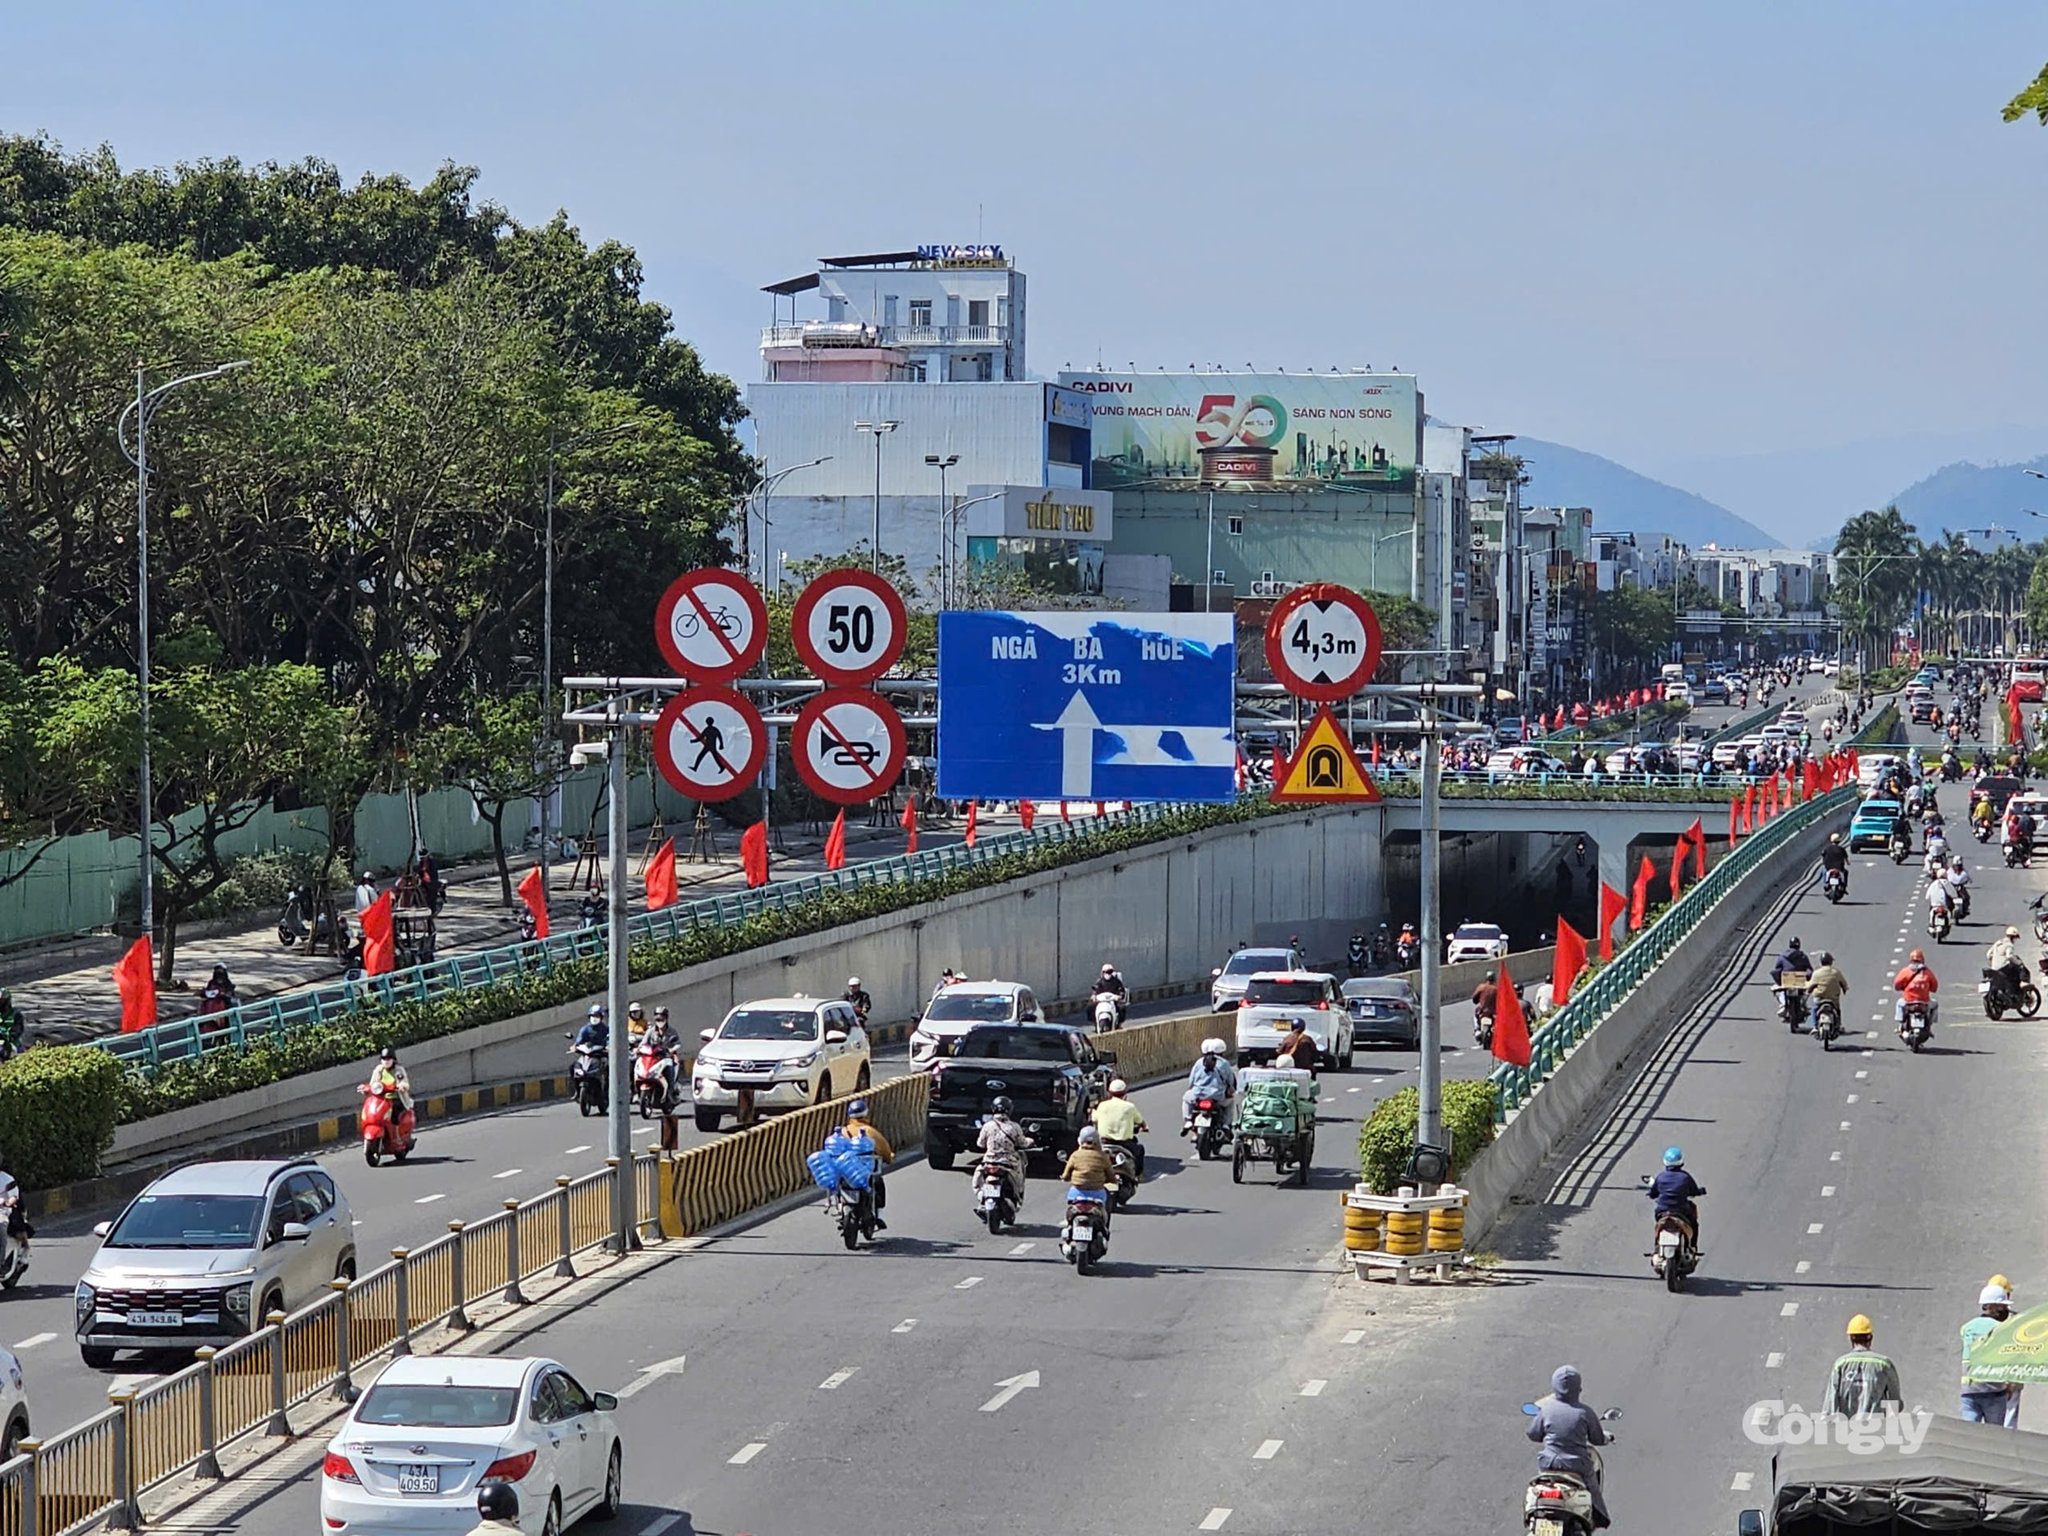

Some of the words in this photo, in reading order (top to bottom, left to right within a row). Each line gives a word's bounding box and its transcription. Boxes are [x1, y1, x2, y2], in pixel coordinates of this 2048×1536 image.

[917, 245, 959, 259] NEW
[965, 245, 1000, 258] SKY
[1072, 381, 1132, 393] CADIVI
[1330, 408, 1355, 418] NON
[1218, 463, 1257, 471] CADIVI
[1064, 504, 1094, 532] THU
[828, 605, 874, 654] 50
[991, 629, 1037, 660] NGÃ
[1073, 637, 1103, 660] BA
[1292, 619, 1356, 662] 4,3m
[1062, 663, 1121, 685] 3Km
[408, 1464, 429, 1478] 43A
[400, 1478, 436, 1491] 409.50
